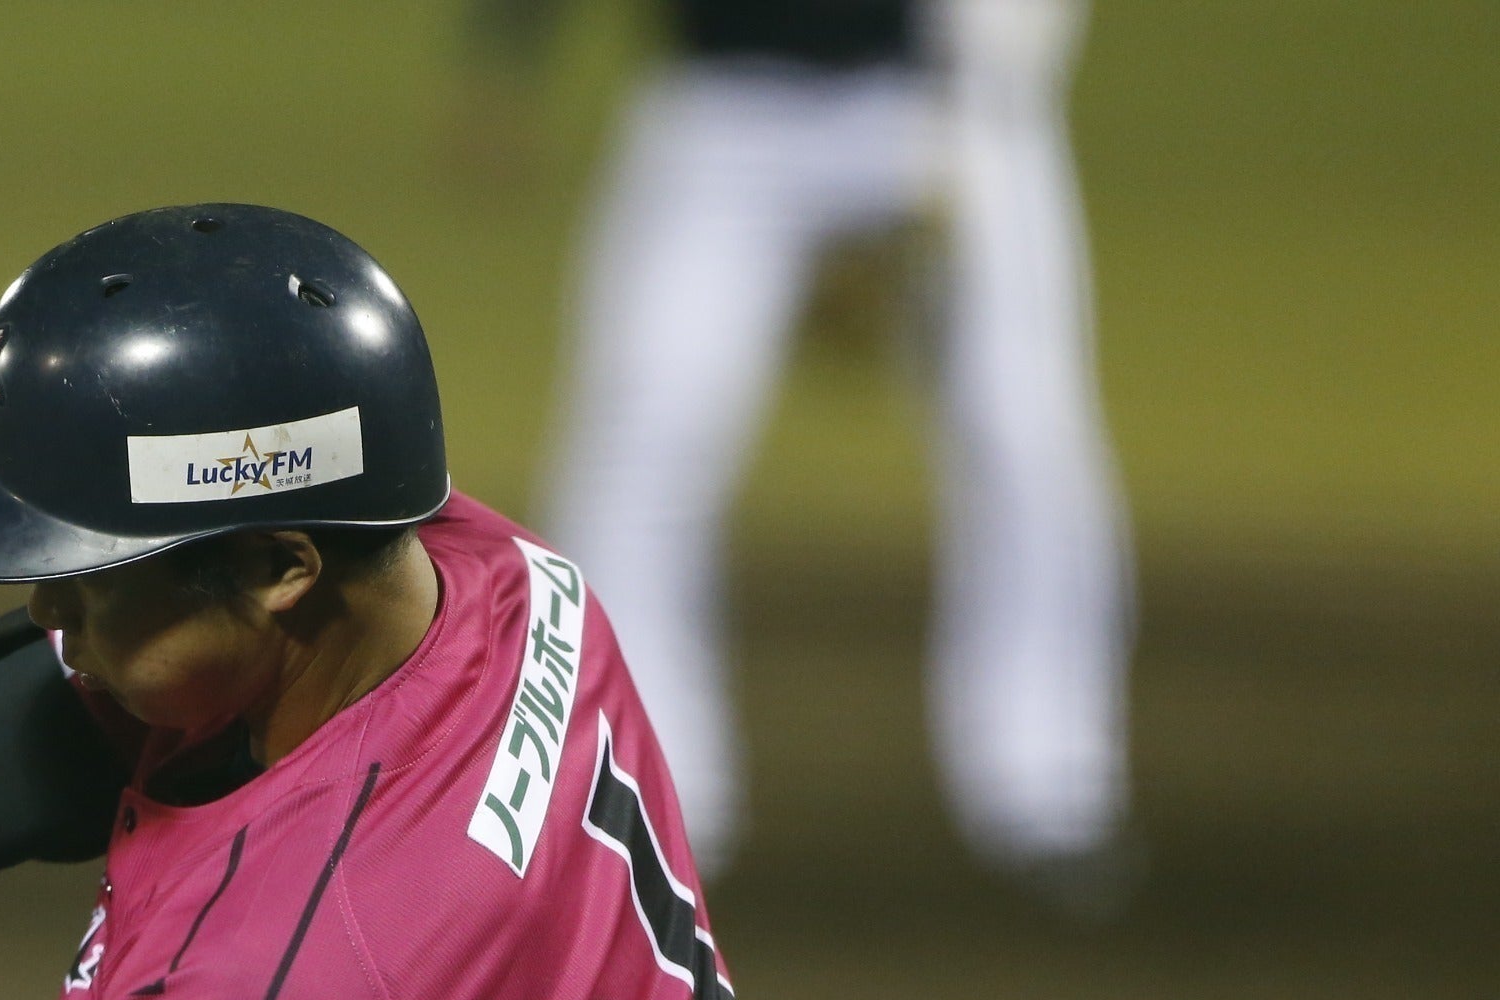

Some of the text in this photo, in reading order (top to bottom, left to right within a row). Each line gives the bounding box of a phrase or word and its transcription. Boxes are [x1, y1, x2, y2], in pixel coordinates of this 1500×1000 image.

[484, 556, 579, 871] ノーブルホーム
